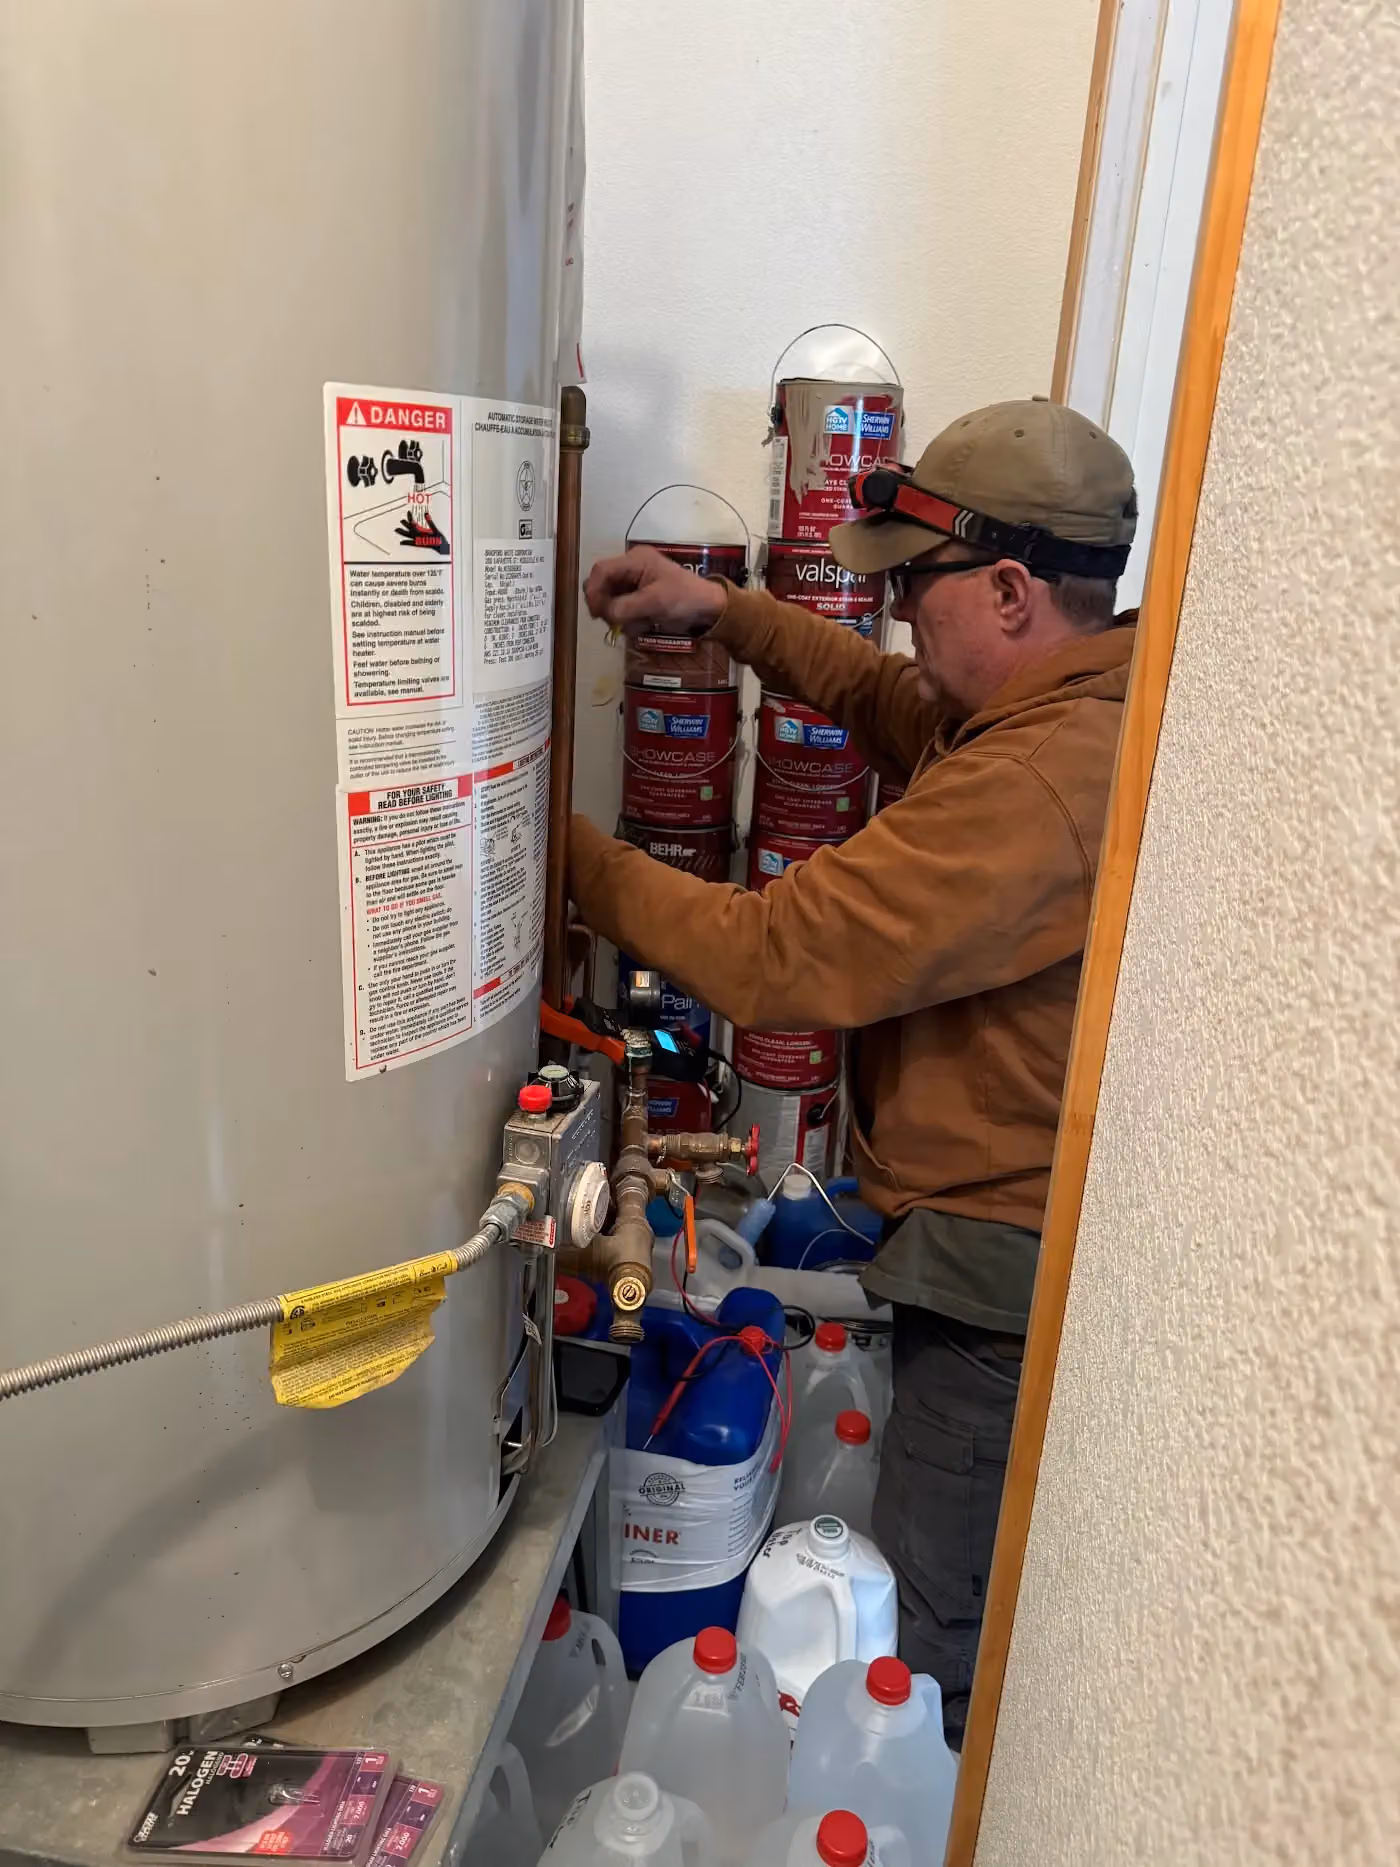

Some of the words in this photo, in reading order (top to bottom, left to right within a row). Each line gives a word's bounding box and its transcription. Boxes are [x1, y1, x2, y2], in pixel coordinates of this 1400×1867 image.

[371, 407, 446, 428] DANGER
[408, 492, 432, 504] HOT
[416, 537, 442, 545] BURN
[372, 570, 410, 578] temperature
[350, 590, 379, 598] instantly
[373, 610, 396, 619] highest
[354, 681, 395, 690] Temperature
[811, 727, 843, 736] SHERWIN
[809, 735, 842, 744] WILLIAMS
[403, 788, 420, 798] YOUR
[423, 784, 444, 794] SAFETY
[378, 800, 396, 809] READ
[399, 796, 423, 806] BEFORE
[426, 790, 452, 802] LIGHTING
[353, 817, 383, 825] WARNING:
[395, 820, 417, 828] explosion
[354, 835, 376, 843] property
[377, 832, 398, 840] damage,
[400, 828, 419, 836] personal
[421, 823, 432, 832] injury
[416, 839, 425, 847] pilot
[650, 842, 682, 856] BEHR
[397, 857, 424, 866] instructions
[387, 868, 410, 878] LIGHTING
[431, 860, 445, 868] around
[366, 881, 389, 889] appliance
[395, 884, 414, 892] because
[639, 1484, 685, 1494] ORIGINAL
[176, 1751, 218, 1815] HALOGEN
